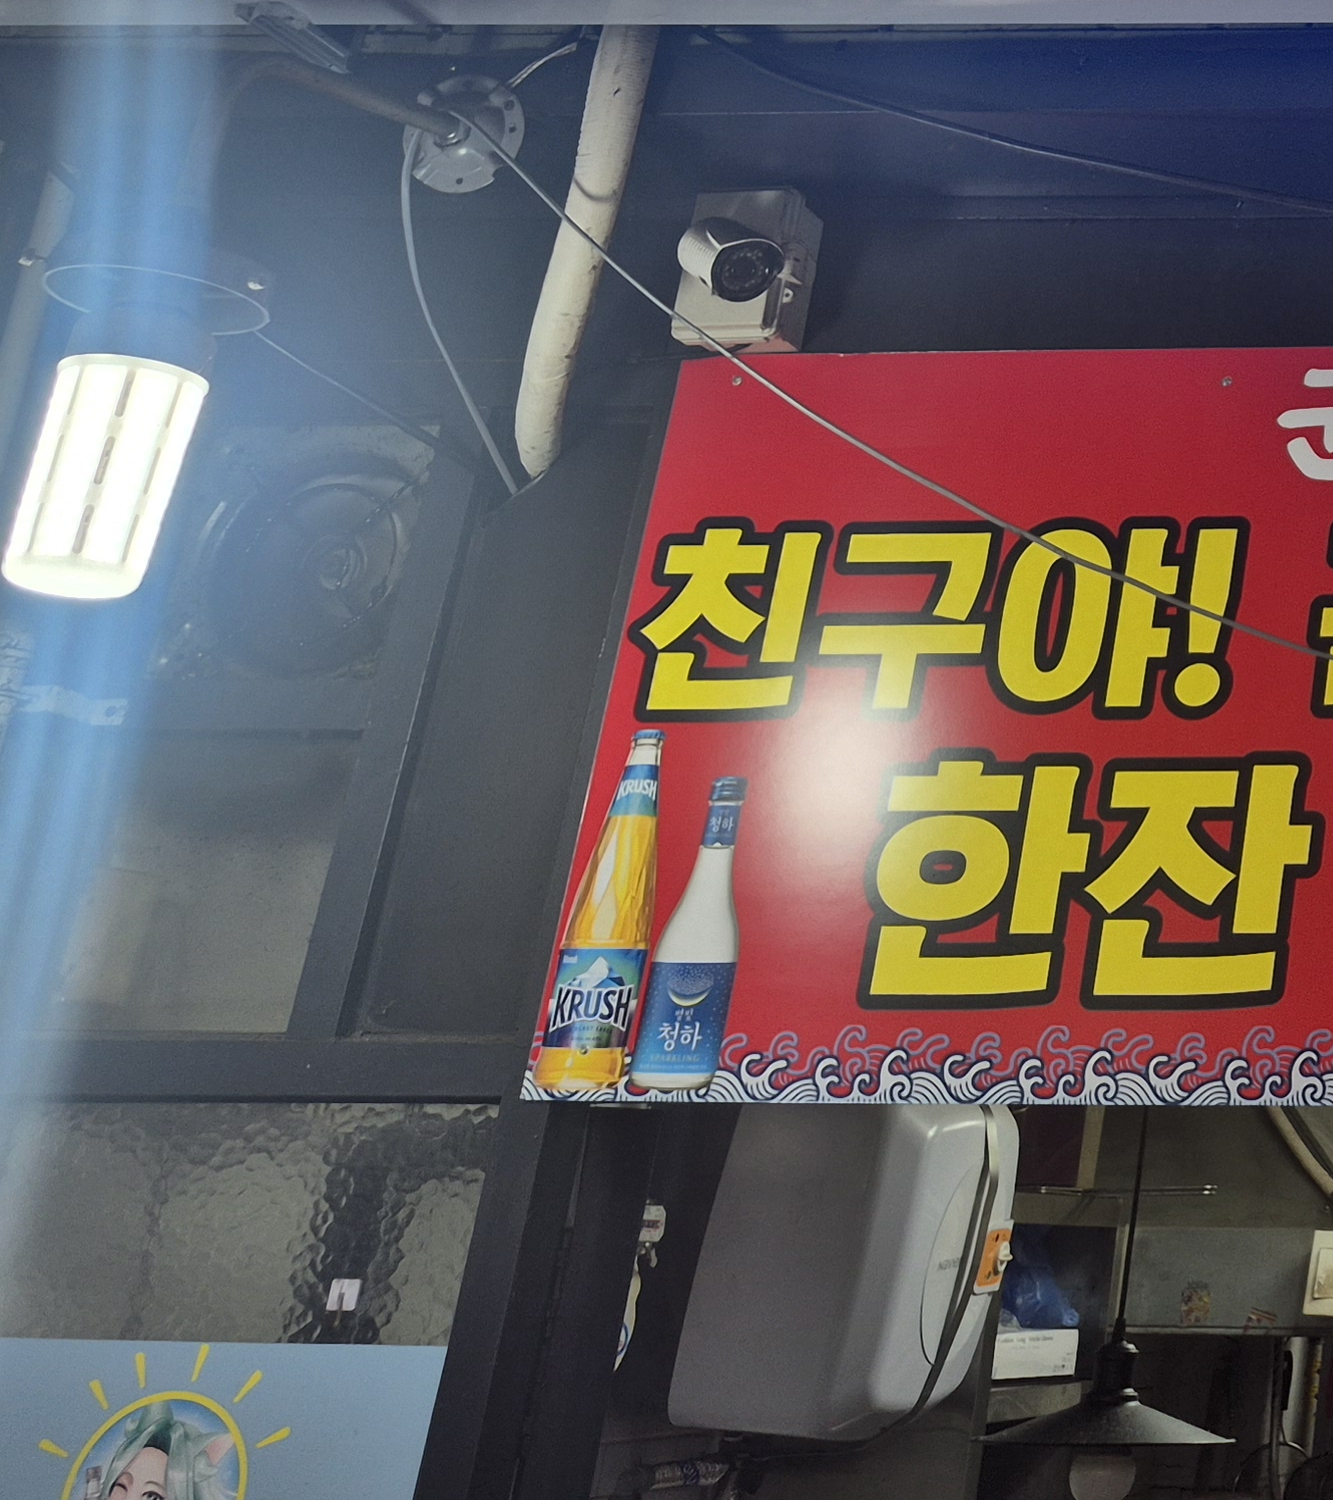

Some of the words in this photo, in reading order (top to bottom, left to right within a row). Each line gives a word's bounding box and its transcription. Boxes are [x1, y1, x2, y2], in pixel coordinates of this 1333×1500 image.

[632, 518, 1245, 716] 친구야!
[617, 778, 658, 800] KRUSH
[708, 815, 735, 833] 청하
[864, 754, 1318, 1002] 한잔
[549, 984, 635, 1033] KRUSH
[656, 1021, 703, 1052] 청하
